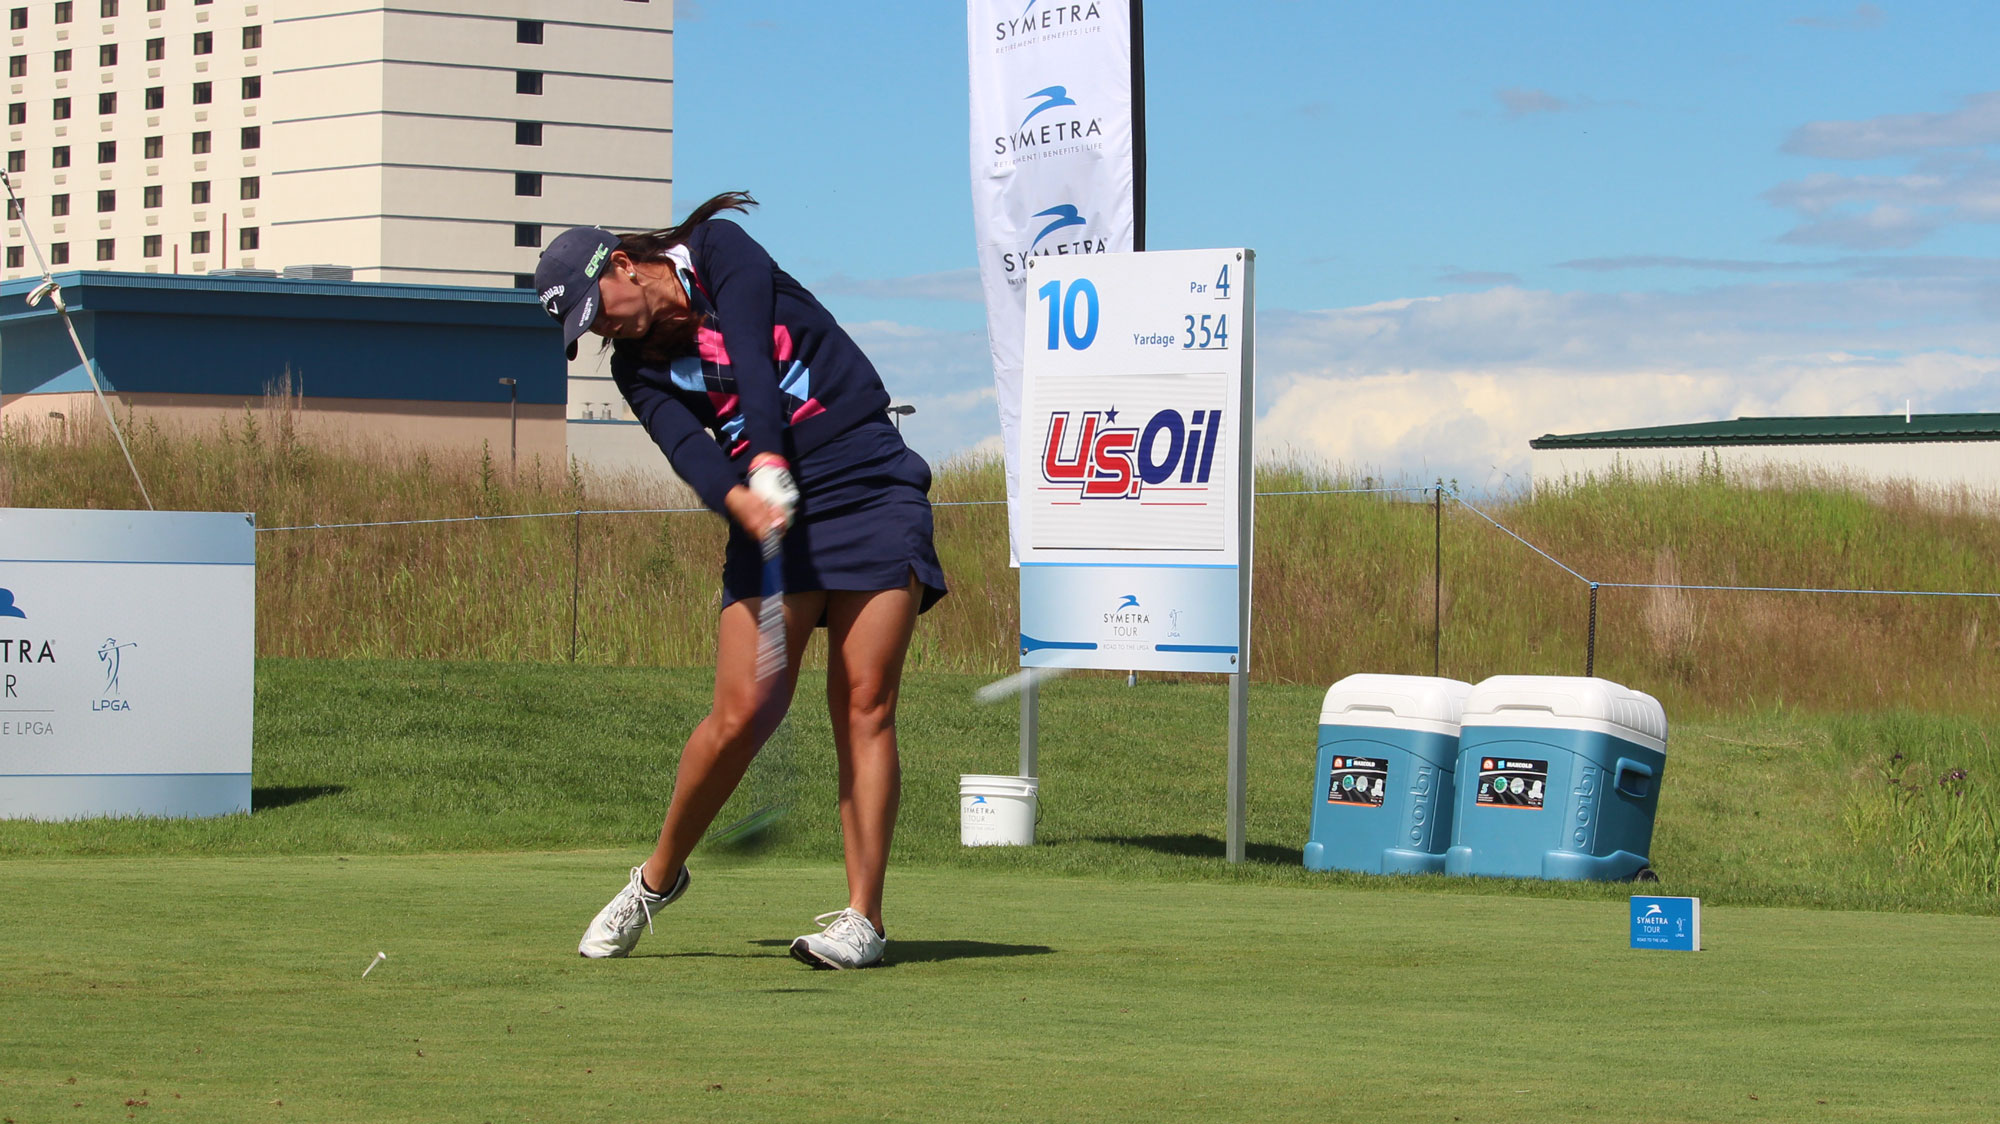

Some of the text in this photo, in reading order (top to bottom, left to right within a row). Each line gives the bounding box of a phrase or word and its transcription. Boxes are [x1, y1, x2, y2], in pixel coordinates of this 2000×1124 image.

[996, 2, 1100, 40] SYMETRA
[995, 26, 1101, 54] RETIREMENT BENEFITS LIFE
[994, 118, 1102, 155] SYMETRA
[1043, 146, 1079, 158] BENEFITS
[1086, 143, 1103, 151] LIFE
[584, 242, 609, 278] EPIC
[1190, 264, 1230, 298] Par 4
[540, 285, 565, 304] laway
[1038, 278, 1100, 351] 10
[1133, 313, 1228, 349] Yardage 354
[1103, 613, 1150, 624] SYMETRA
[1113, 626, 1138, 637] TOUR
[92, 699, 130, 712] LPGA
[17, 721, 54, 735] LPGA
[1636, 916, 1669, 925] SYMETRA
[1643, 925, 1660, 933] TOUR
